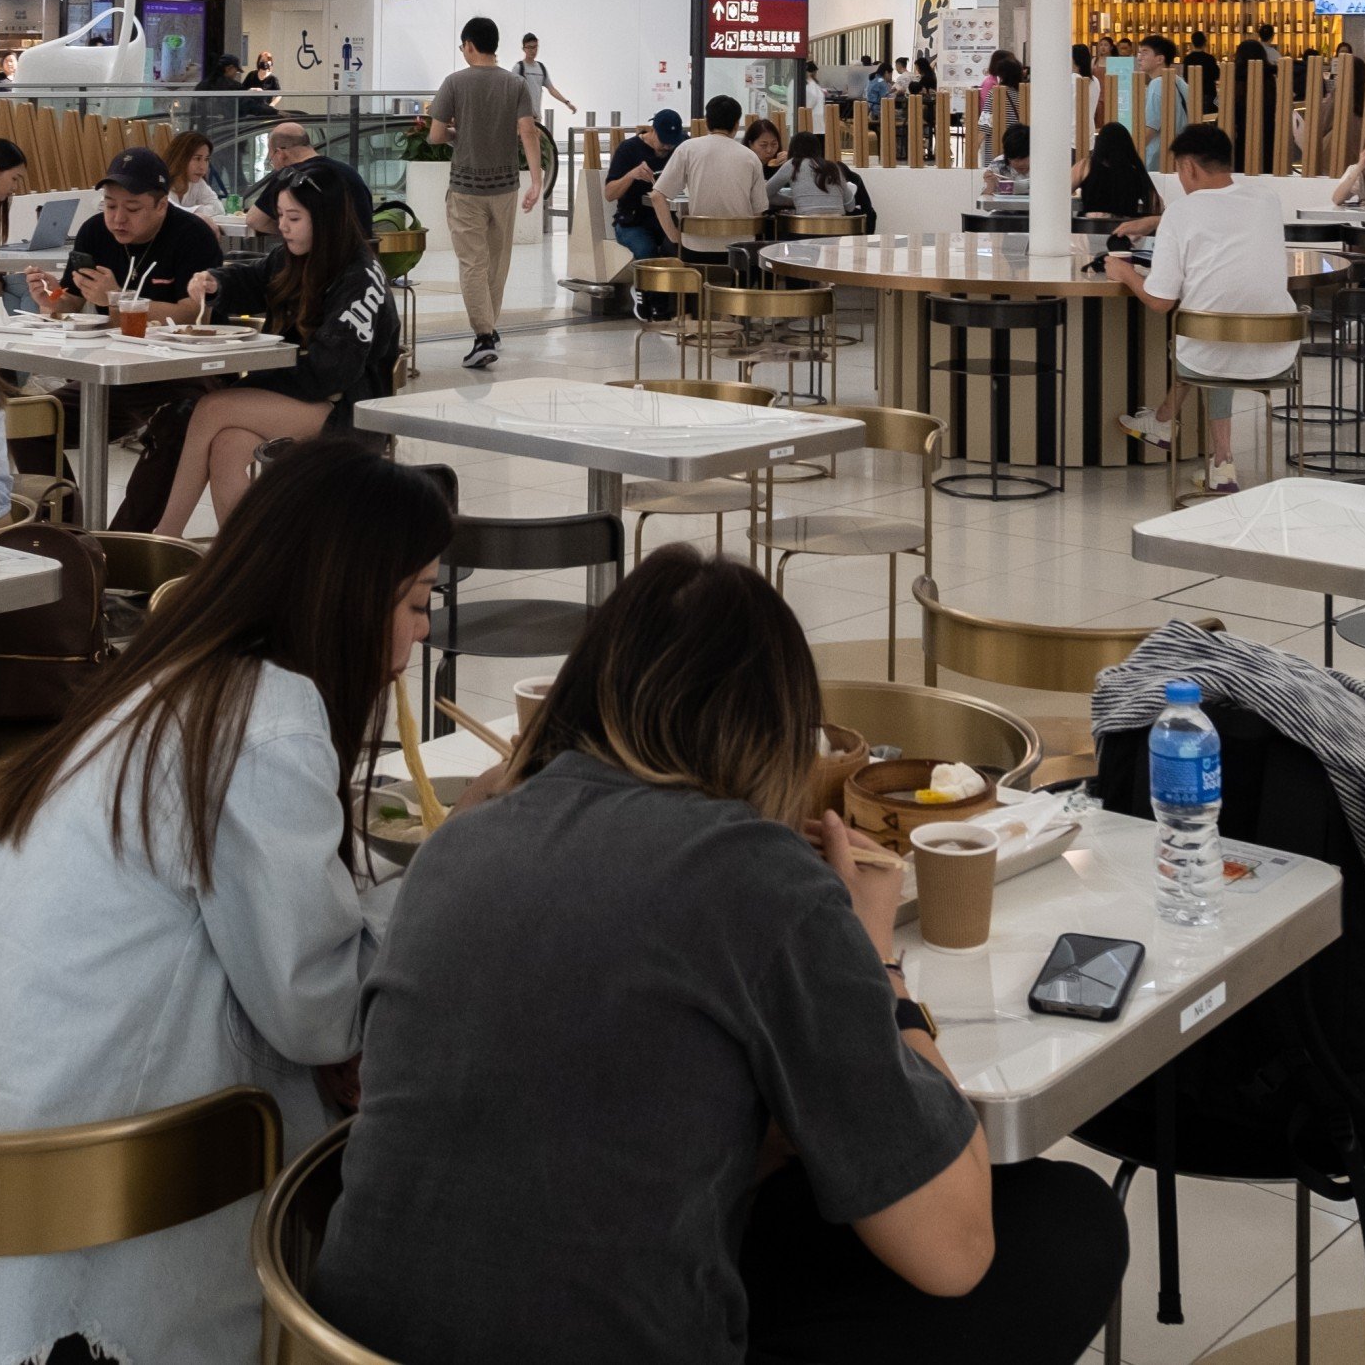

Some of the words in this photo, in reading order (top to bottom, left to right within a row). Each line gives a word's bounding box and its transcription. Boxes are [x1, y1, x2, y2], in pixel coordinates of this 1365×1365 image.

[741, 0, 759, 13] 商店
[741, 13, 759, 23] Shops
[740, 43, 758, 51] Airline
[759, 43, 781, 52] Services
[782, 43, 795, 52] Desk
